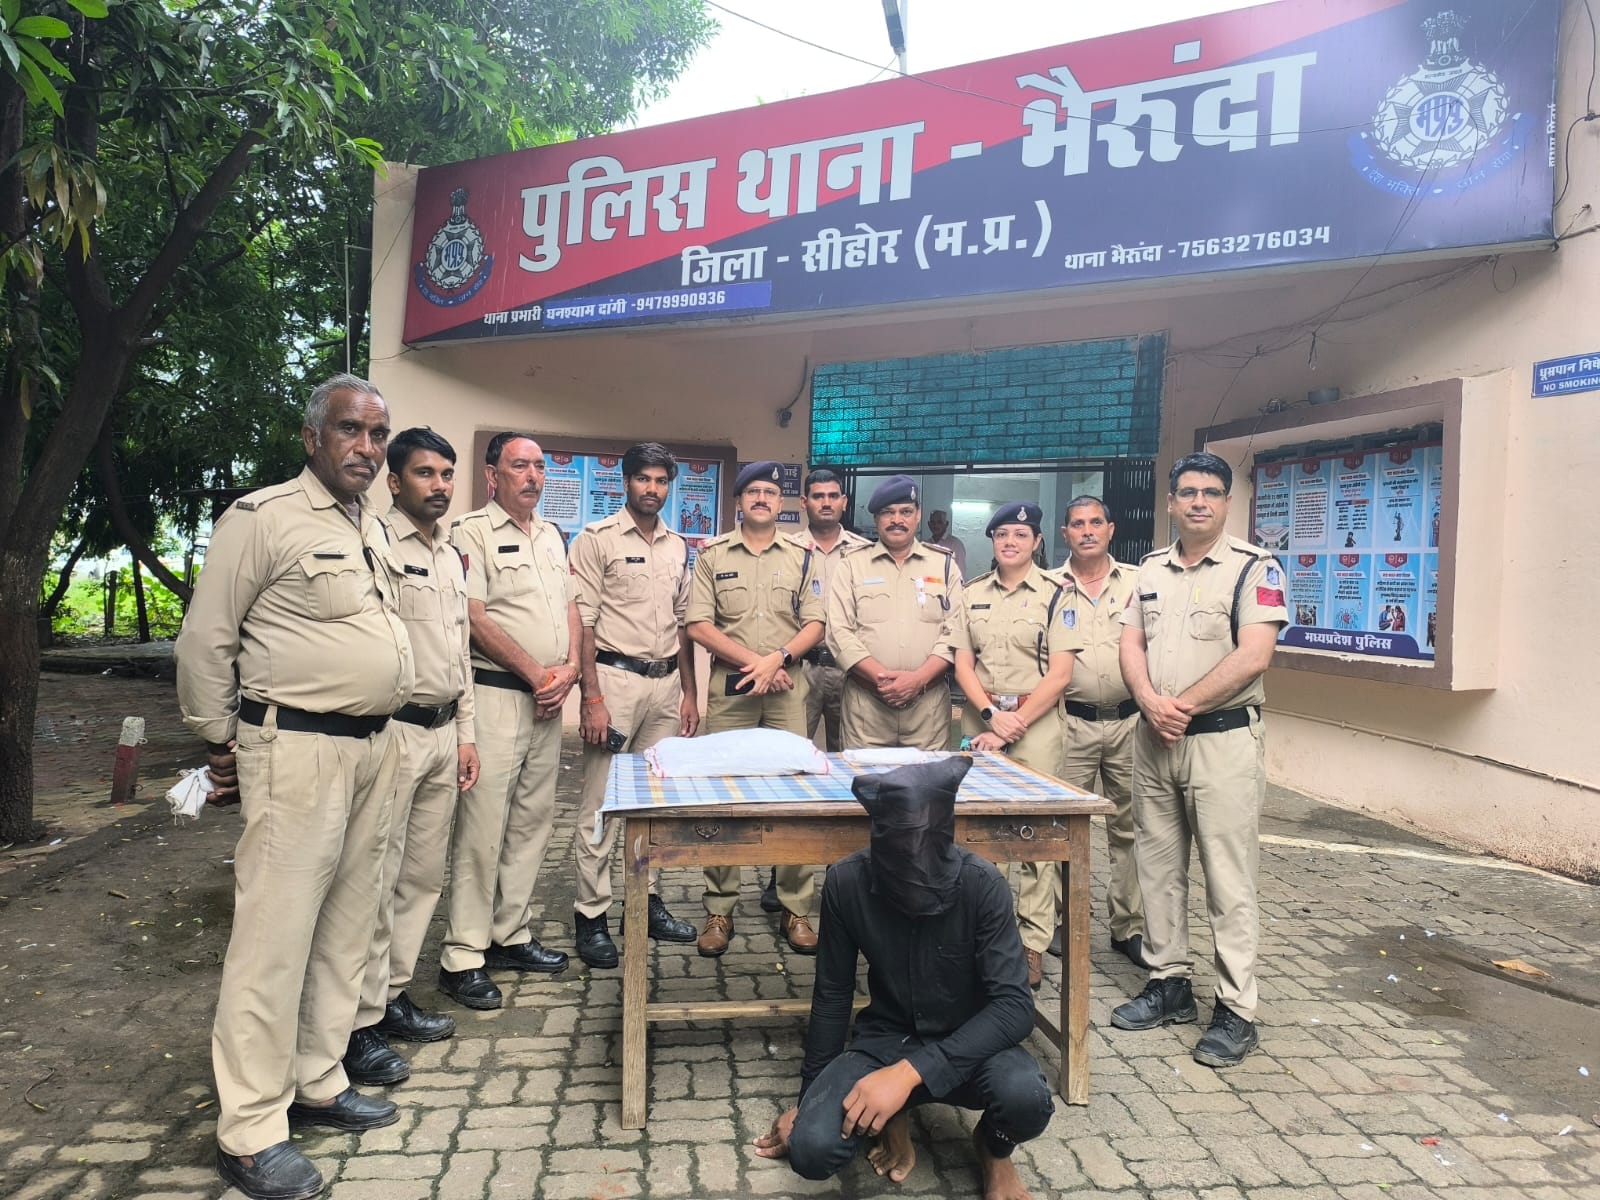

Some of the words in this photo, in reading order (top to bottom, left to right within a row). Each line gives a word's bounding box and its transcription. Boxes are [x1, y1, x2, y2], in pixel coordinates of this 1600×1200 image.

[519, 156, 717, 273] पुलिस
[736, 120, 926, 219] थाना
[680, 245, 768, 286] जिला
[801, 223, 903, 273] सीहोर
[1064, 250, 1108, 270] थाना
[483, 311, 508, 325] थाना
[511, 306, 542, 324] प्रभारी
[598, 299, 628, 315] दांगी
[1543, 383, 1556, 392] NO
[1558, 376, 1600, 390] SMOKIN
[1304, 631, 1353, 646] मध्यप्रदेश
[1355, 634, 1393, 651] पुलिस
